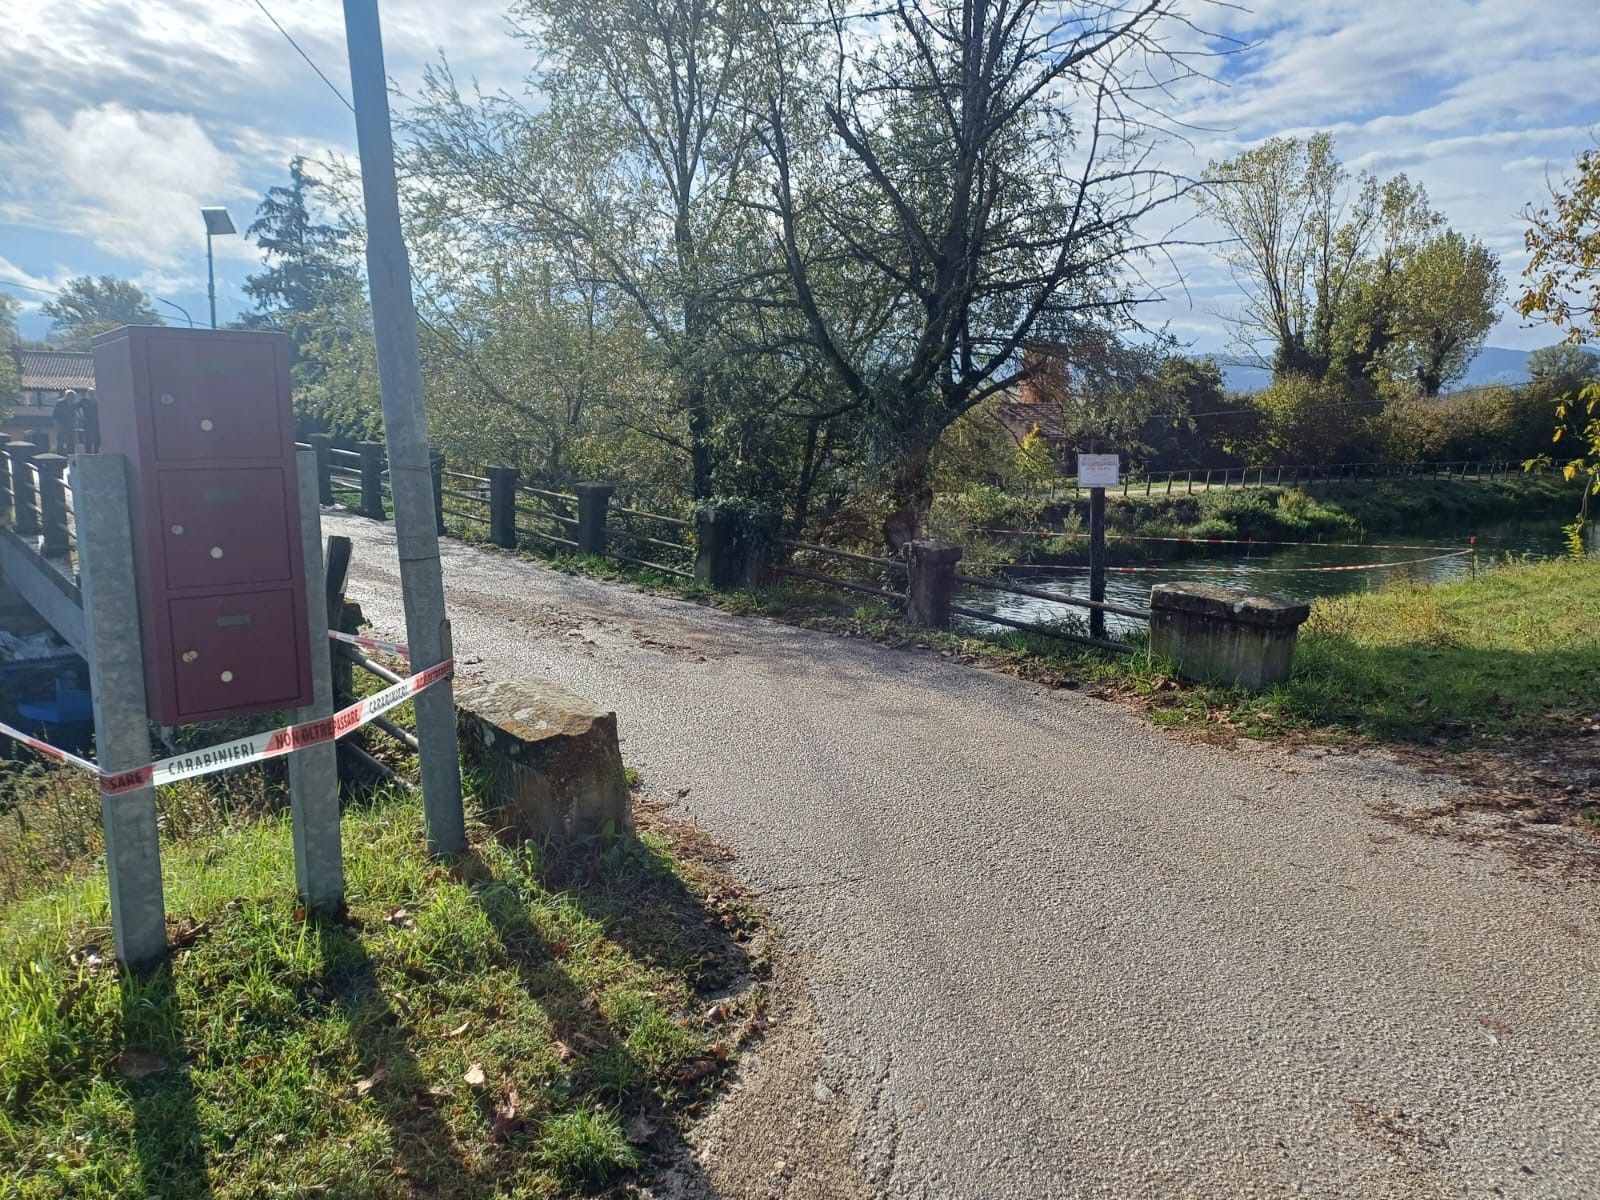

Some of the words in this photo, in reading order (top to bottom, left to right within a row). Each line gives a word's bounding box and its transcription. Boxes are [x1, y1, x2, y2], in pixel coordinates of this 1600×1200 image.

[168, 741, 255, 776] CARABINIERI
[275, 729, 299, 749] NON
[368, 684, 410, 714] CARABINIERI
